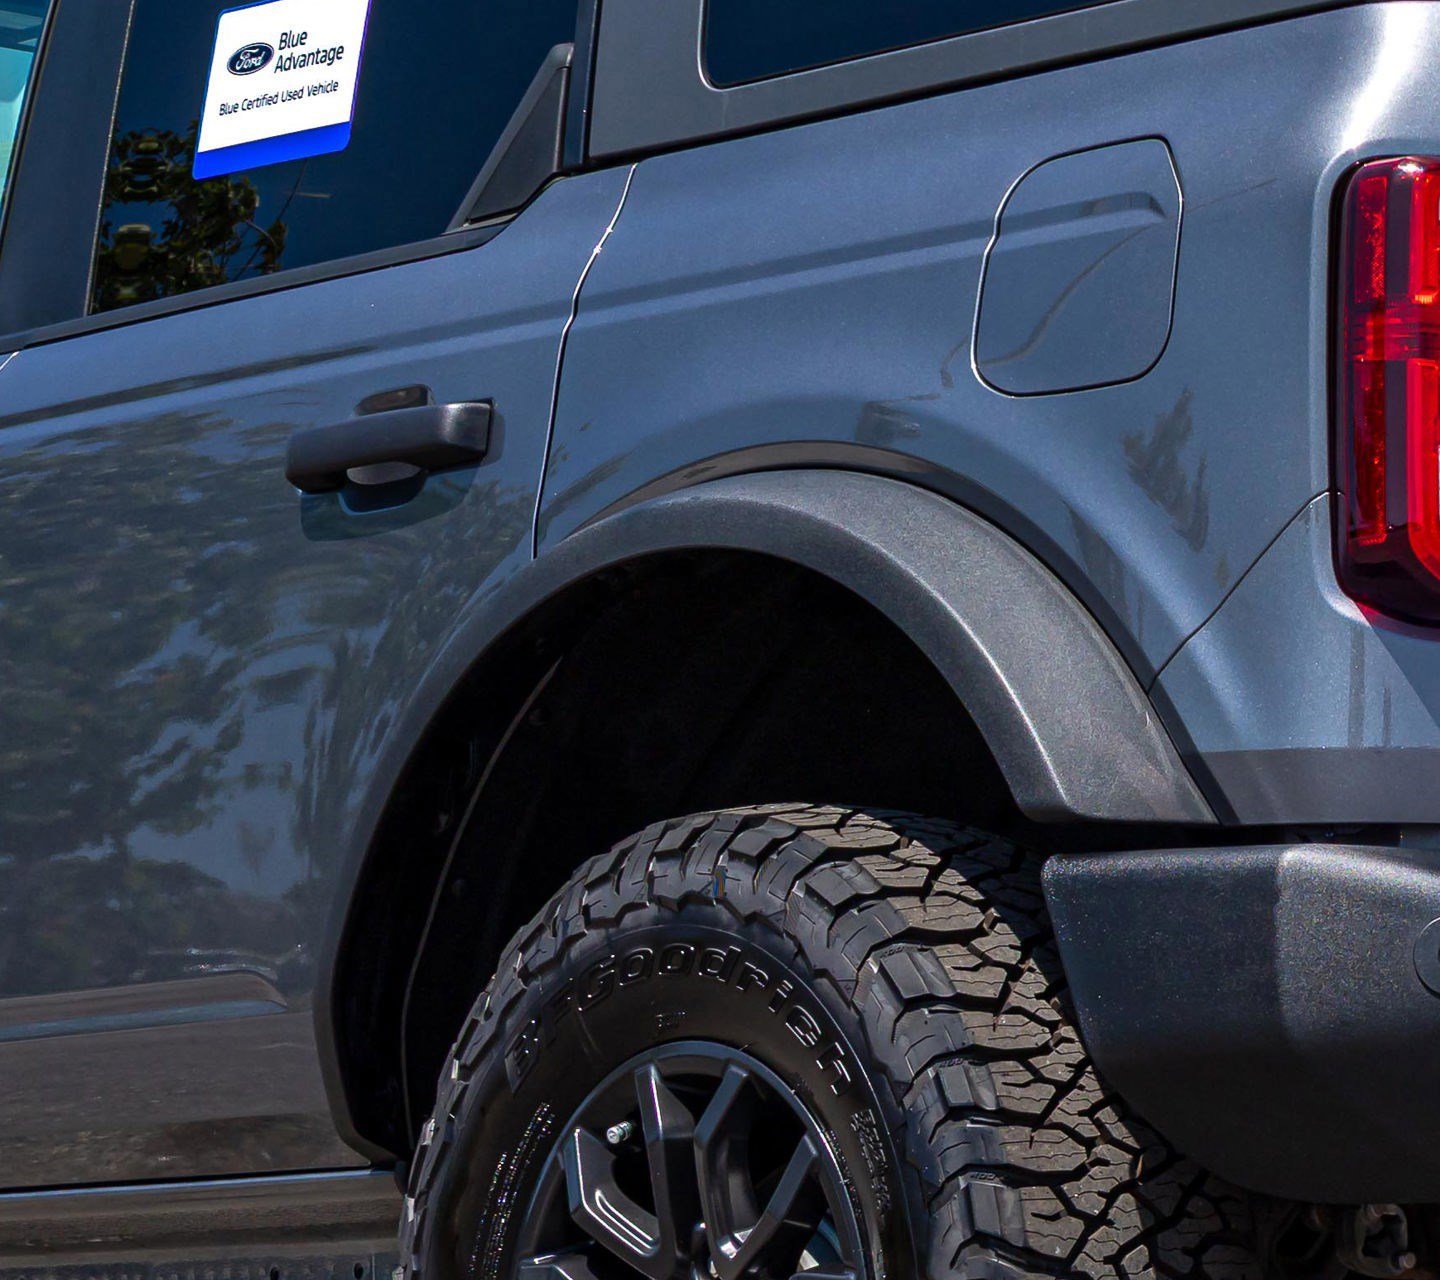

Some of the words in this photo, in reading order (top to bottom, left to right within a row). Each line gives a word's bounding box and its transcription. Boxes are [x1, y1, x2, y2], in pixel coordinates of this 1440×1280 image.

[278, 30, 308, 51] Blue
[274, 44, 345, 73] Advantage
[219, 100, 239, 116] Blue
[241, 93, 278, 111] Certified
[281, 88, 304, 105] Used
[307, 79, 339, 97] Vehicle
[505, 942, 851, 1095] BFGoodrich
